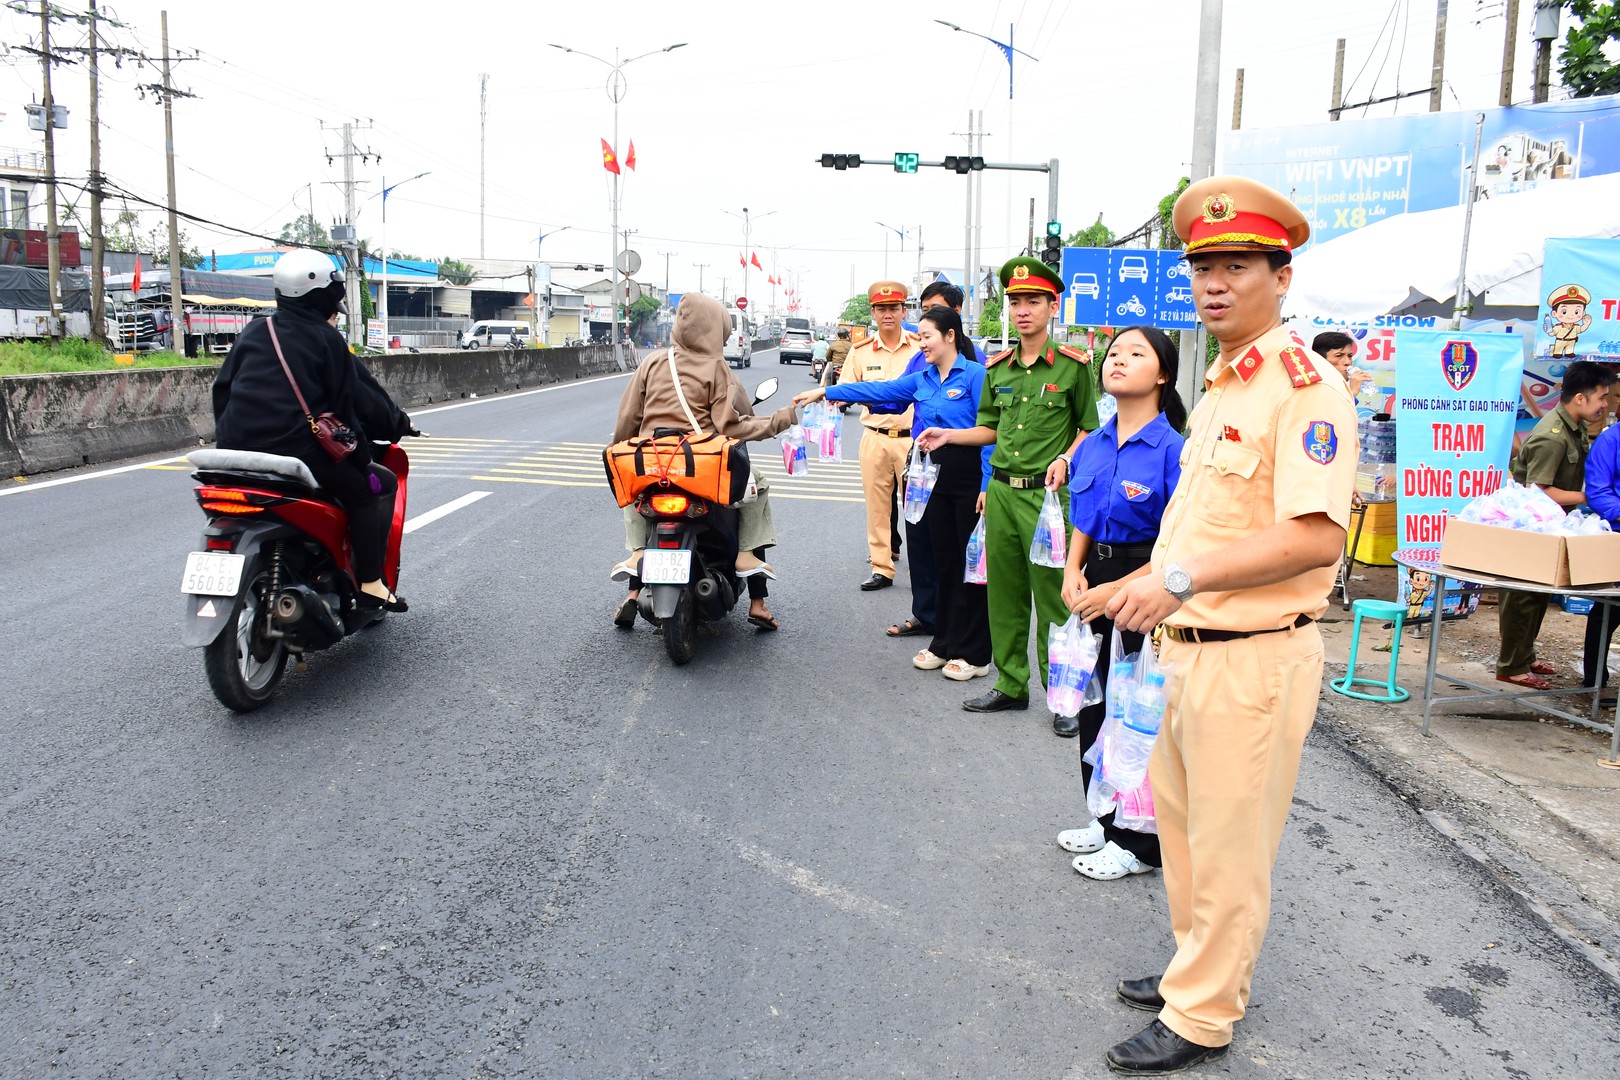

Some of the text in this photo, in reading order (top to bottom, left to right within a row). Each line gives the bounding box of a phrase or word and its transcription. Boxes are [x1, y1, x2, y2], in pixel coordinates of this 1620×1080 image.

[1285, 146, 1340, 158] INTERNET
[895, 154, 918, 173] 42
[1285, 155, 1409, 182] WIFI VNPT
[1383, 187, 1409, 201] NHÀ
[1333, 208, 1367, 229] X8
[254, 255, 275, 266] PVOIL
[1160, 310, 1167, 321] XE
[1167, 311, 1172, 321] 2
[1172, 308, 1179, 322] VÀ
[1180, 311, 1184, 322] 3
[1601, 299, 1620, 320] T
[1374, 315, 1436, 328] SHOW
[1447, 364, 1470, 373] CS GT
[1401, 395, 1515, 413] PHÒNG CẢNH SÁT GIAO THÔNG
[1431, 423, 1485, 458] TRẠM
[1404, 463, 1503, 498] DỪNG CHÂN
[188, 574, 235, 592] 560.68
